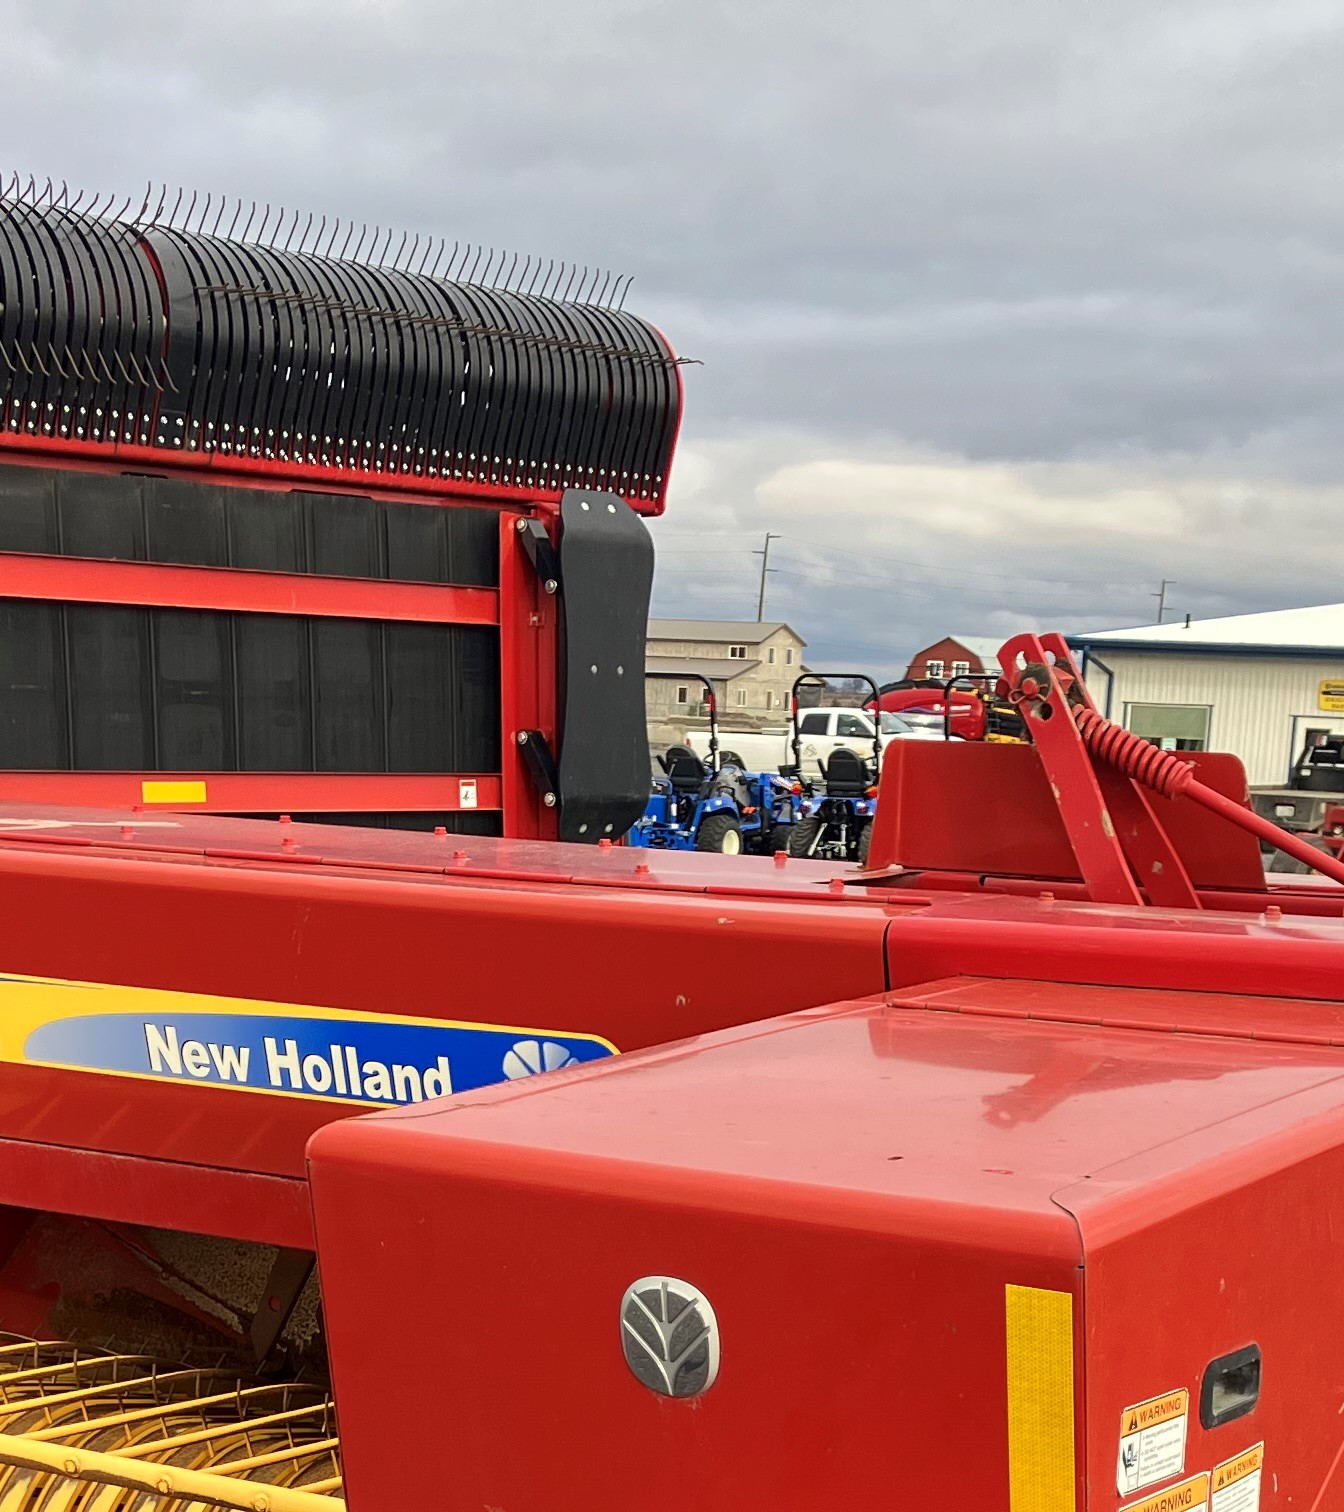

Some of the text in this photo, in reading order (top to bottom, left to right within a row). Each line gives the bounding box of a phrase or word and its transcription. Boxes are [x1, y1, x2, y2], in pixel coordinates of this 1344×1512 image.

[143, 1022, 453, 1103] New Holland
[1139, 1398, 1182, 1422] WARNING
